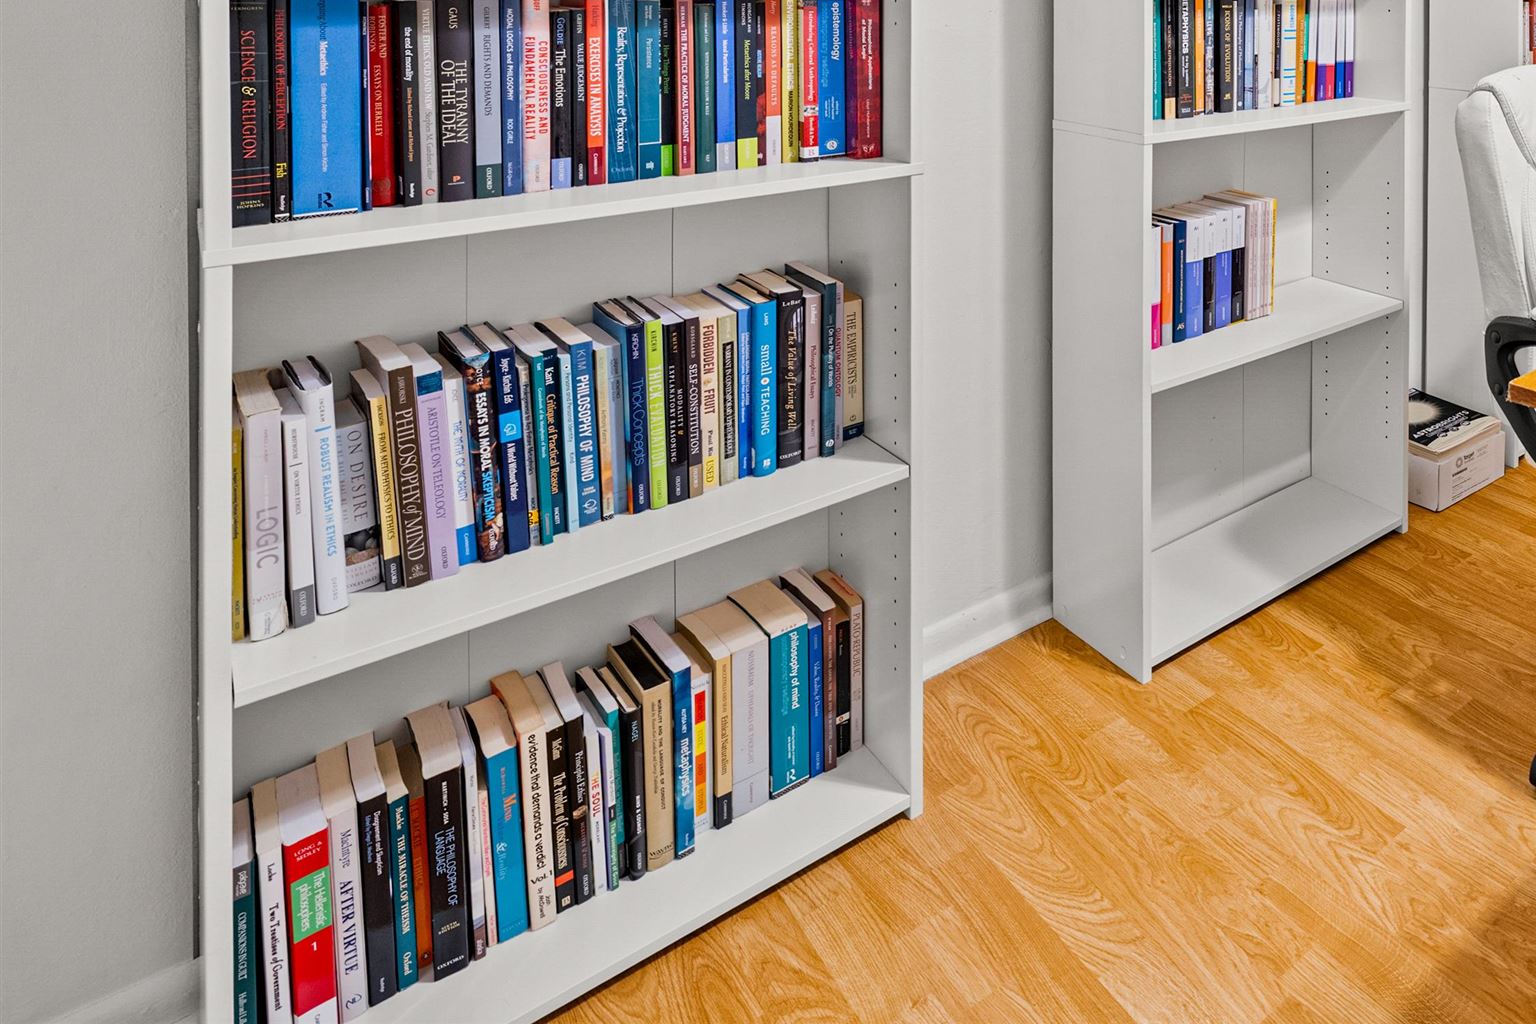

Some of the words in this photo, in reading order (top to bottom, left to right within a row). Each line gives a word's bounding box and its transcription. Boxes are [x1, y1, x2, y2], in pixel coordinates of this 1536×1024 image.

[275, 9, 284, 60] PHILOSOPHY
[449, 8, 457, 29] GAUS
[557, 18, 565, 44] GOLDIE
[831, 2, 841, 60] epistemology
[483, 34, 491, 61] RIGHTS
[1225, 33, 1231, 42] OF
[240, 30, 255, 82] SCIENCE
[276, 64, 285, 75] OF
[441, 59, 455, 77] OF
[455, 61, 467, 84] THE
[525, 37, 535, 100] FUNDAMENTAL
[555, 49, 565, 66] The
[590, 37, 601, 81] EXERCISES
[442, 79, 455, 107] THE
[539, 41, 547, 112] CONSCIOUSNESS
[555, 68, 565, 107] Emotions
[591, 84, 601, 93] IN
[615, 54, 626, 106] Representation
[276, 77, 286, 130] PERCEPTION
[456, 87, 468, 143] TYRANNY
[591, 96, 601, 136] ANALYSIS
[242, 99, 257, 159] RELIGION
[442, 109, 456, 147] IDEAL
[525, 104, 535, 140] REALITY
[539, 117, 548, 134] AND
[617, 117, 627, 152] Projection
[276, 162, 286, 178] Fish
[846, 312, 856, 332] THE
[576, 349, 585, 370] KIM
[703, 325, 714, 375] FORBIDDEN
[761, 345, 772, 375] small
[846, 334, 857, 385] EMPIRICISTS
[476, 392, 487, 425] ESSAYS
[577, 375, 590, 437] PHILOSOPHY
[689, 364, 699, 455] SELF-CONSTITUTION
[703, 389, 715, 414] FRUIT
[761, 386, 770, 435] TEACHING
[347, 431, 363, 458] ON
[427, 407, 440, 452] ARISTOTLE
[478, 426, 487, 437] IN
[579, 441, 590, 452] OF
[395, 408, 419, 505] PHILOSOPHY
[431, 454, 441, 470] ON
[479, 438, 490, 470] MORAL
[580, 455, 593, 481] MIND
[706, 460, 714, 483] USED
[350, 464, 368, 522] DESIRE
[404, 505, 423, 515] of
[432, 472, 446, 519] TELEOLOGY
[481, 471, 495, 520] SKEPTICISM
[255, 505, 279, 569] LOGIC
[406, 517, 425, 560] MIND
[528, 734, 538, 773] evidence
[679, 738, 692, 797] metaphysics
[530, 774, 539, 792] that
[530, 793, 541, 833] demands
[592, 792, 601, 817] SOUL
[397, 835, 406, 853] THE
[445, 827, 455, 842] THE
[435, 831, 445, 876] LANGUAGE
[445, 844, 457, 893] PHILOSOPHY
[533, 841, 546, 869] verdict
[313, 871, 324, 888] The
[397, 853, 408, 892] MIRACLE
[296, 883, 310, 932] philosophers
[314, 889, 328, 928] Hellenistic
[339, 880, 355, 923] AFTER
[400, 893, 408, 903] OF
[448, 895, 458, 905] OF
[401, 904, 410, 935] THEISM
[344, 926, 358, 975] VIRTUE
